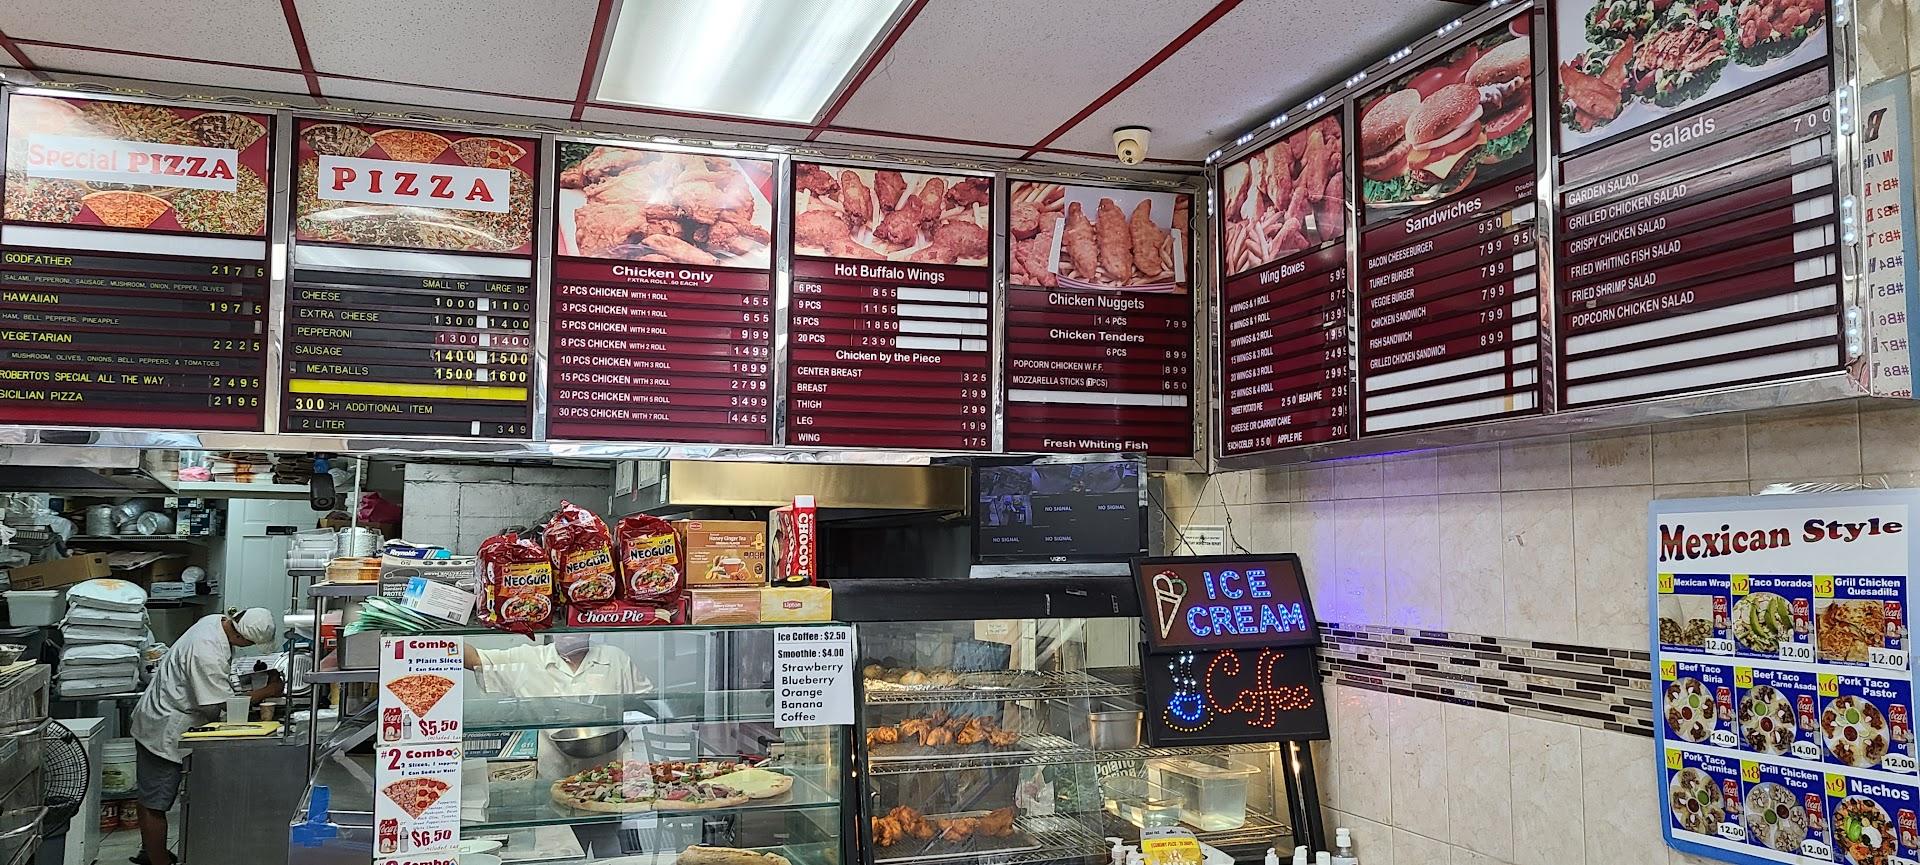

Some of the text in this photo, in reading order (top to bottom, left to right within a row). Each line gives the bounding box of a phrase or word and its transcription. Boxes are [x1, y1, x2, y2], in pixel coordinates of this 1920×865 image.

[1650, 116, 1716, 152] Salads
[28, 144, 234, 180] Special PIZZA
[331, 166, 494, 202] PIZZA
[1569, 184, 1606, 205] GARDEN
[1607, 174, 1639, 194] SALAD
[1569, 184, 1686, 230] GRILLED CHICKEN SALAD
[1406, 197, 1481, 233] Sandwiches
[5, 254, 72, 266] GODFATHER
[1369, 240, 1433, 269] BACON CHEESEBURGER
[612, 265, 713, 283] Chicken Only
[834, 263, 945, 284] Hot Buffalo Wings
[1260, 261, 1305, 284] Wing Boxes
[1369, 267, 1414, 289] TURKEY BURGER
[423, 279, 451, 290] SMALL
[485, 283, 511, 293] LARGE
[563, 286, 568, 294] 2
[569, 286, 587, 295] PCS
[589, 287, 628, 297] CHICKEN
[799, 284, 822, 293] 6 PCS
[3, 292, 58, 304] HAWAIIAN
[302, 291, 341, 301] CHEESE
[1049, 293, 1145, 311] Chicken Nuggets
[562, 303, 567, 311] 3
[569, 304, 587, 312] PCS
[588, 305, 628, 315] CHICKEN
[1572, 290, 1694, 328] POPCORN CHICKEN SALAD
[300, 309, 379, 322] EXTRA CHEESE
[1371, 307, 1426, 329] CHICKEN SANDWICH
[1, 331, 72, 343] VEGETARIAN
[297, 327, 352, 338] PEPPERONI
[1050, 329, 1145, 342] Chicken Tenders
[295, 345, 342, 356] SAUSAGE
[561, 356, 571, 364] 10
[572, 356, 590, 365] PCS
[592, 357, 631, 367] CHICKEN
[836, 350, 940, 364] Chicken by the Piece
[307, 364, 368, 375] MEATBALLS
[1013, 360, 1049, 368] POPCORN
[1051, 362, 1083, 370] CHICKEN
[0, 370, 164, 385] ROBERTO'S SPECIAL ALL THE WAY
[797, 367, 829, 375] CENTER
[831, 368, 862, 377] BREAST
[1013, 376, 1084, 386] MOZZARELLA STICKS
[797, 384, 827, 392] BREAST
[0, 389, 83, 401] SICILIAN PIZZA
[1299, 390, 1322, 404] BEAN PIE
[345, 402, 403, 413] ADDITIONAL
[409, 404, 433, 414] ITEM
[797, 400, 822, 408] THIGH
[559, 408, 569, 417] 30
[571, 409, 589, 417] PCS
[590, 409, 629, 419] CHICKEN
[302, 419, 345, 429] 2 LITER
[797, 417, 813, 425] LEG
[798, 433, 820, 441] WING
[1278, 434, 1302, 444] APPLE PIE
[1043, 439, 1148, 450] Fresh Whiting Fish
[1659, 518, 1903, 562] Mexican Style
[631, 545, 674, 560] NEOGURI
[567, 553, 610, 573] NEOGURI
[504, 574, 550, 587] NEOGURI
[1203, 570, 1271, 599] ICE
[1674, 578, 1730, 589] Mexican Wrap
[1750, 578, 1812, 587] Taco Dorados
[1834, 578, 1900, 587] Grill Chicken
[1847, 588, 1899, 596] Quesadilla
[577, 610, 644, 624] Choco Pie
[1187, 603, 1306, 636] CREAM
[778, 632, 845, 641] Ice Coffee $2.50
[409, 641, 455, 649] Combo
[1706, 641, 1733, 652] 12.00
[778, 649, 844, 658] Smoothie $4.00
[782, 662, 843, 673] Strawberry
[1679, 663, 1721, 674] Beef Taco
[782, 675, 834, 686] Blueberry
[1703, 675, 1723, 684] Biria
[1771, 680, 1816, 691] Carne Asada
[782, 689, 822, 698] Orange
[1206, 647, 1314, 728] Coffee
[1863, 688, 1897, 698] Pastor
[781, 712, 815, 721] Coffee
[419, 720, 458, 736] $5.50
[1711, 733, 1735, 744] 14.00
[406, 749, 452, 758] Combo
[1701, 763, 1737, 775] Carnitas
[1851, 780, 1910, 800] Nachos
[411, 829, 452, 847] $6.50
